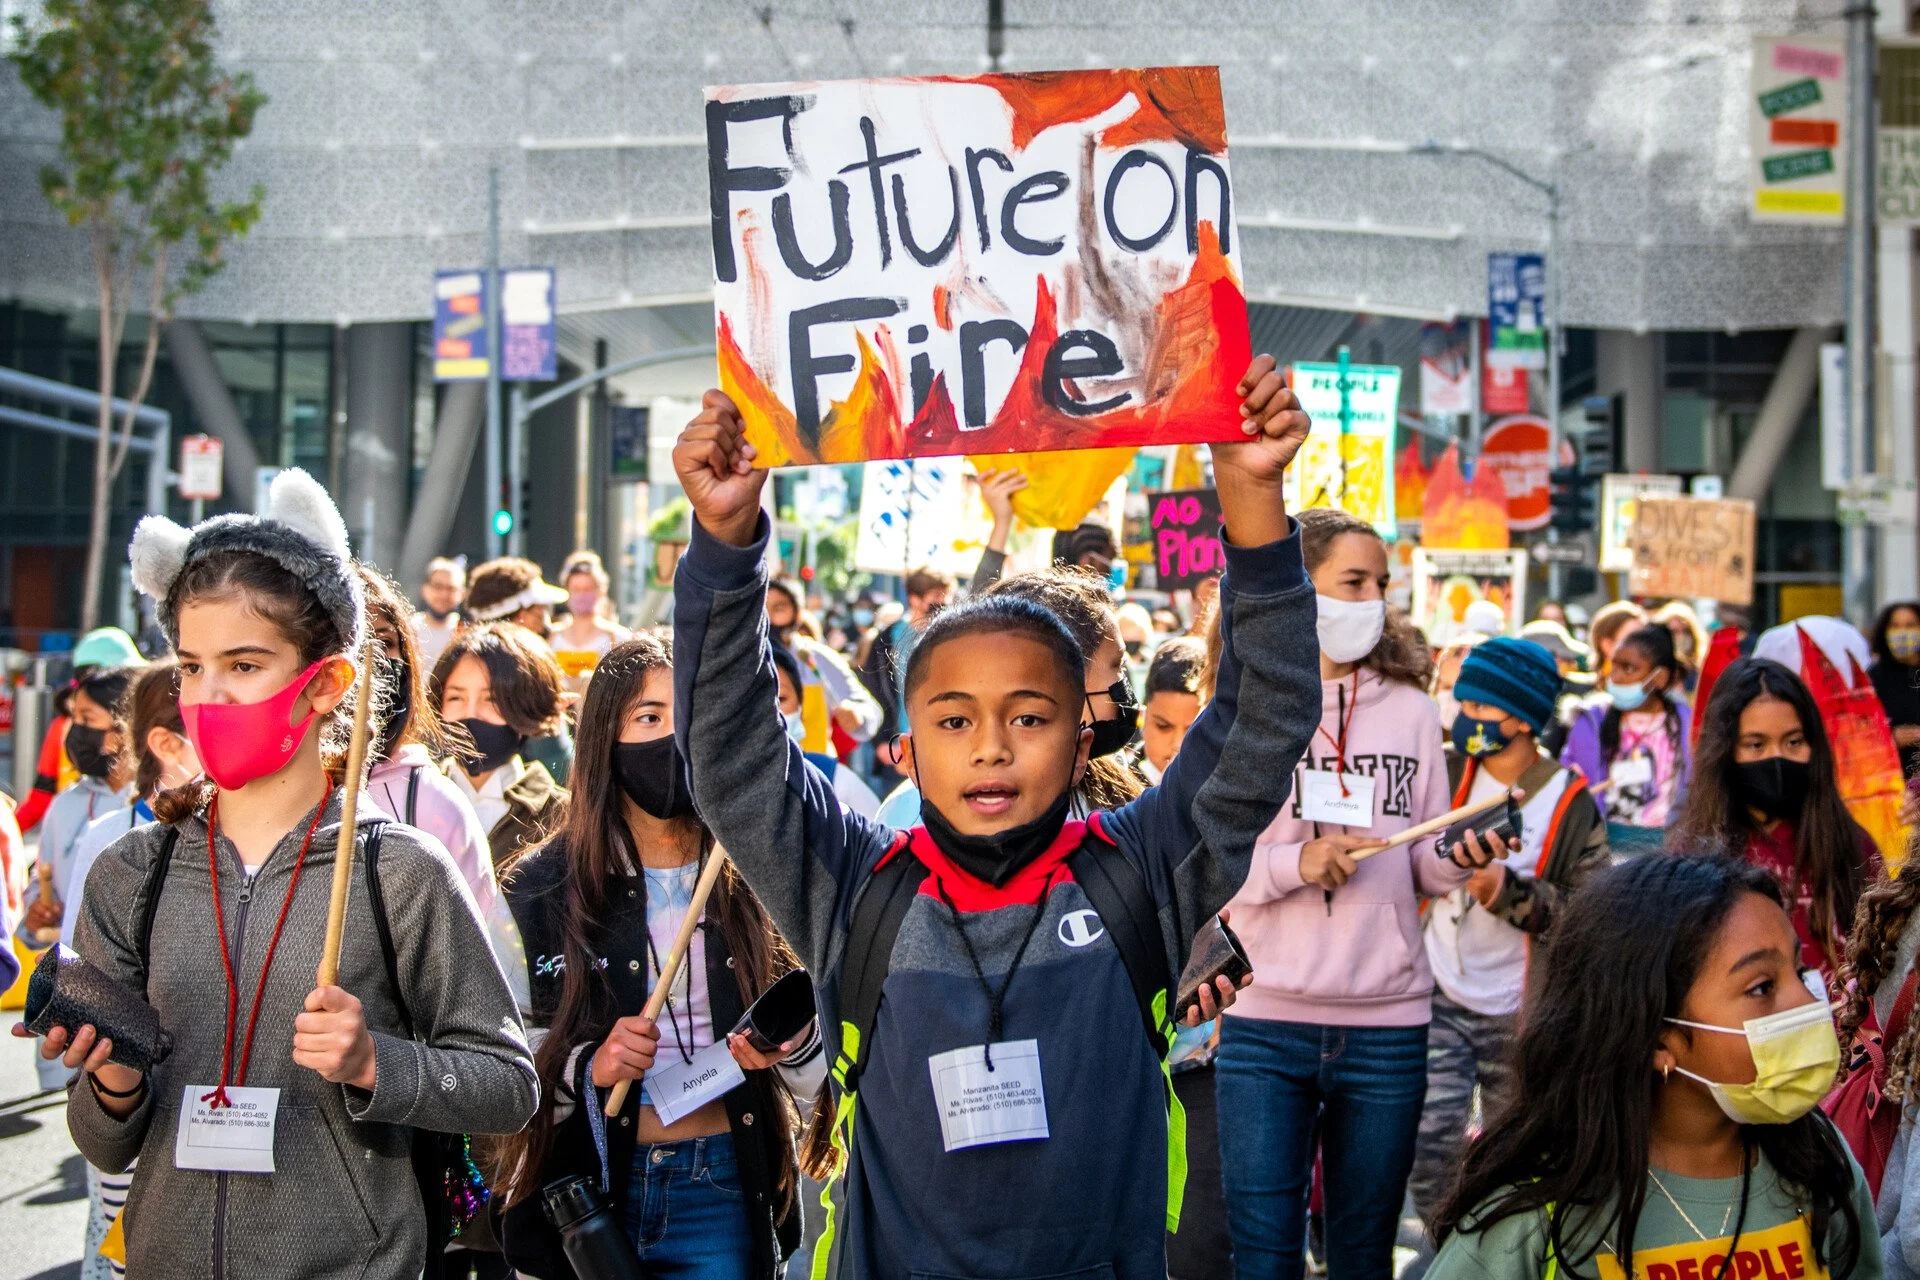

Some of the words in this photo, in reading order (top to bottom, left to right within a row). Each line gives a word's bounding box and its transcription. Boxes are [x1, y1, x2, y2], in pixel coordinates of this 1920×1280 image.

[706, 94, 1070, 282] Future
[1104, 148, 1230, 256] on
[789, 297, 1132, 450] Fire
[1152, 495, 1202, 529] NO
[1637, 499, 1752, 551] DIVEST
[1665, 543, 1719, 567] from
[683, 1068, 718, 1092] Anyela
[963, 1083, 1000, 1096] Manzanita
[1001, 1081, 1021, 1090] SEED
[986, 1091, 1006, 1102] (510)
[993, 1099, 1012, 1110] (510)
[225, 1110, 240, 1118] (510)
[229, 1119, 243, 1127] (510)
[1646, 1242, 1805, 1280] PEOPLE
